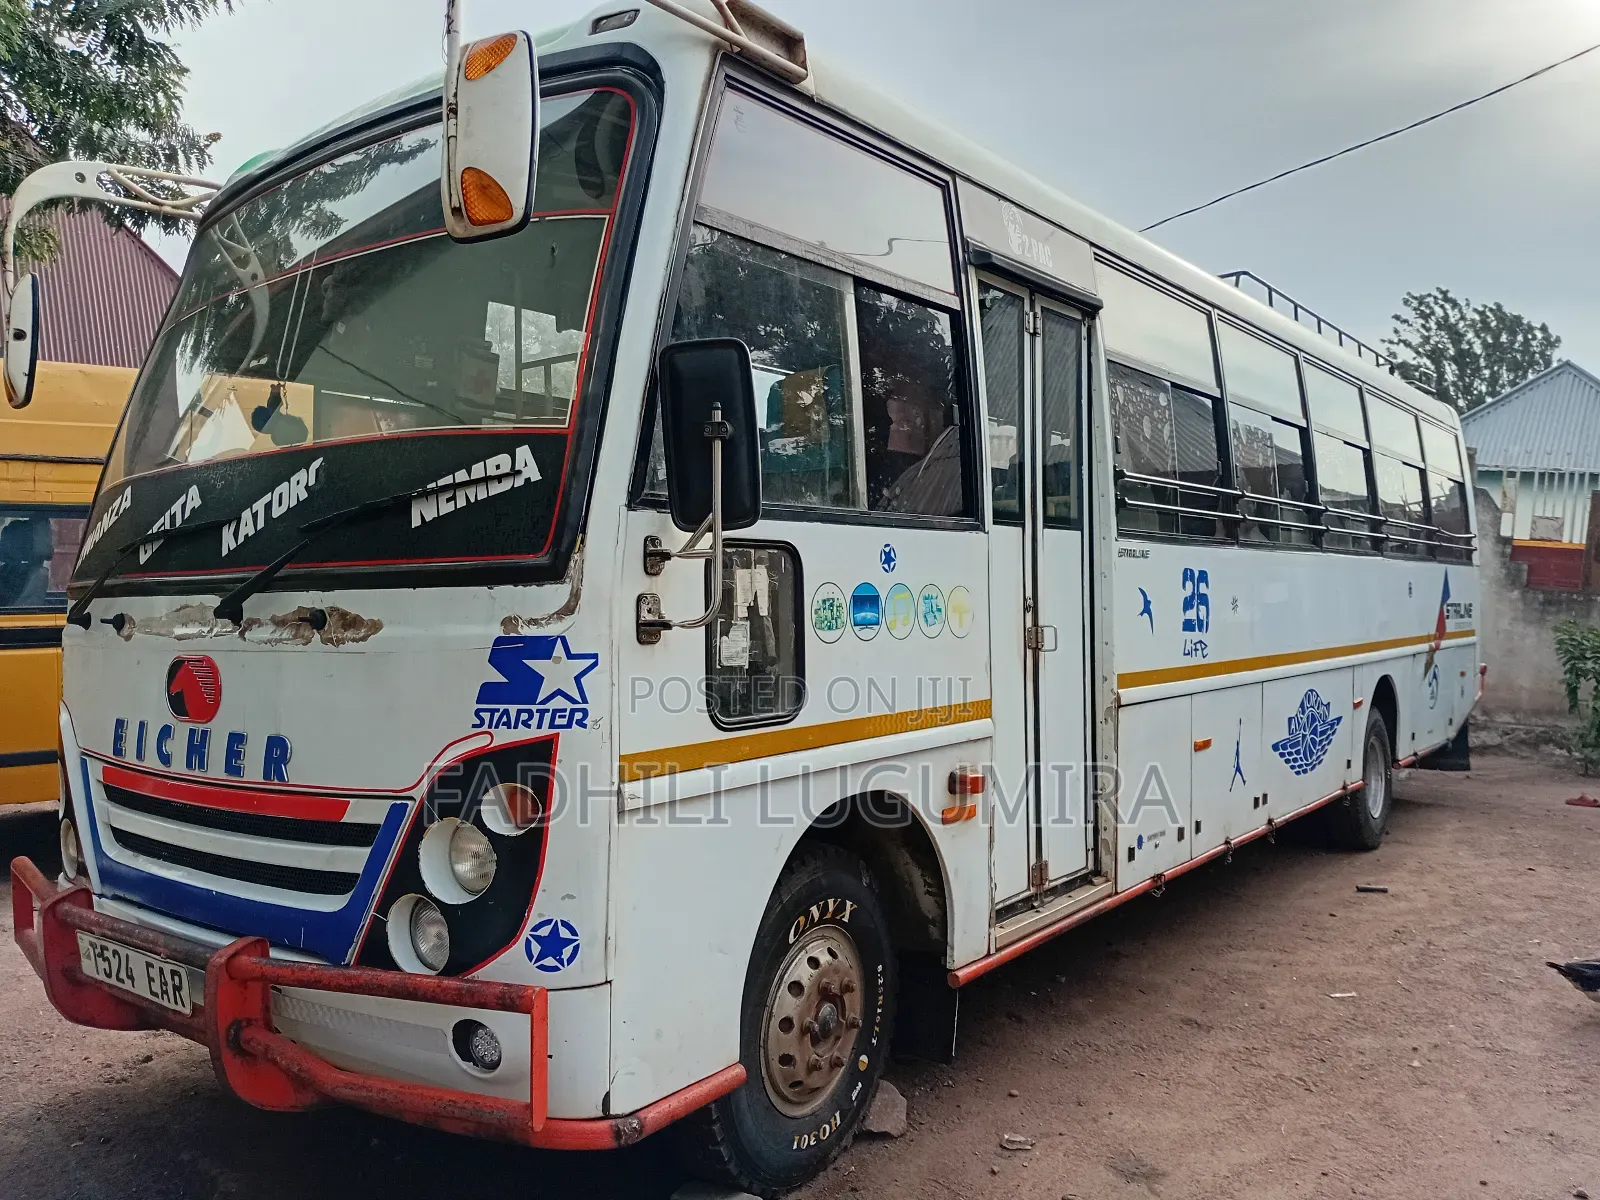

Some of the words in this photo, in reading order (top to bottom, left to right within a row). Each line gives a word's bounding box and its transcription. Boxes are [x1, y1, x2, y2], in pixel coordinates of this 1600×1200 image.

[411, 444, 543, 529] NEMBA
[139, 484, 202, 565] GEITA
[1181, 567, 1210, 634] 26
[112, 717, 293, 783] EICHER
[471, 707, 589, 730] STARTER
[788, 898, 858, 945] ONYX
[89, 940, 135, 989] T524
[145, 960, 186, 1009] EAR
